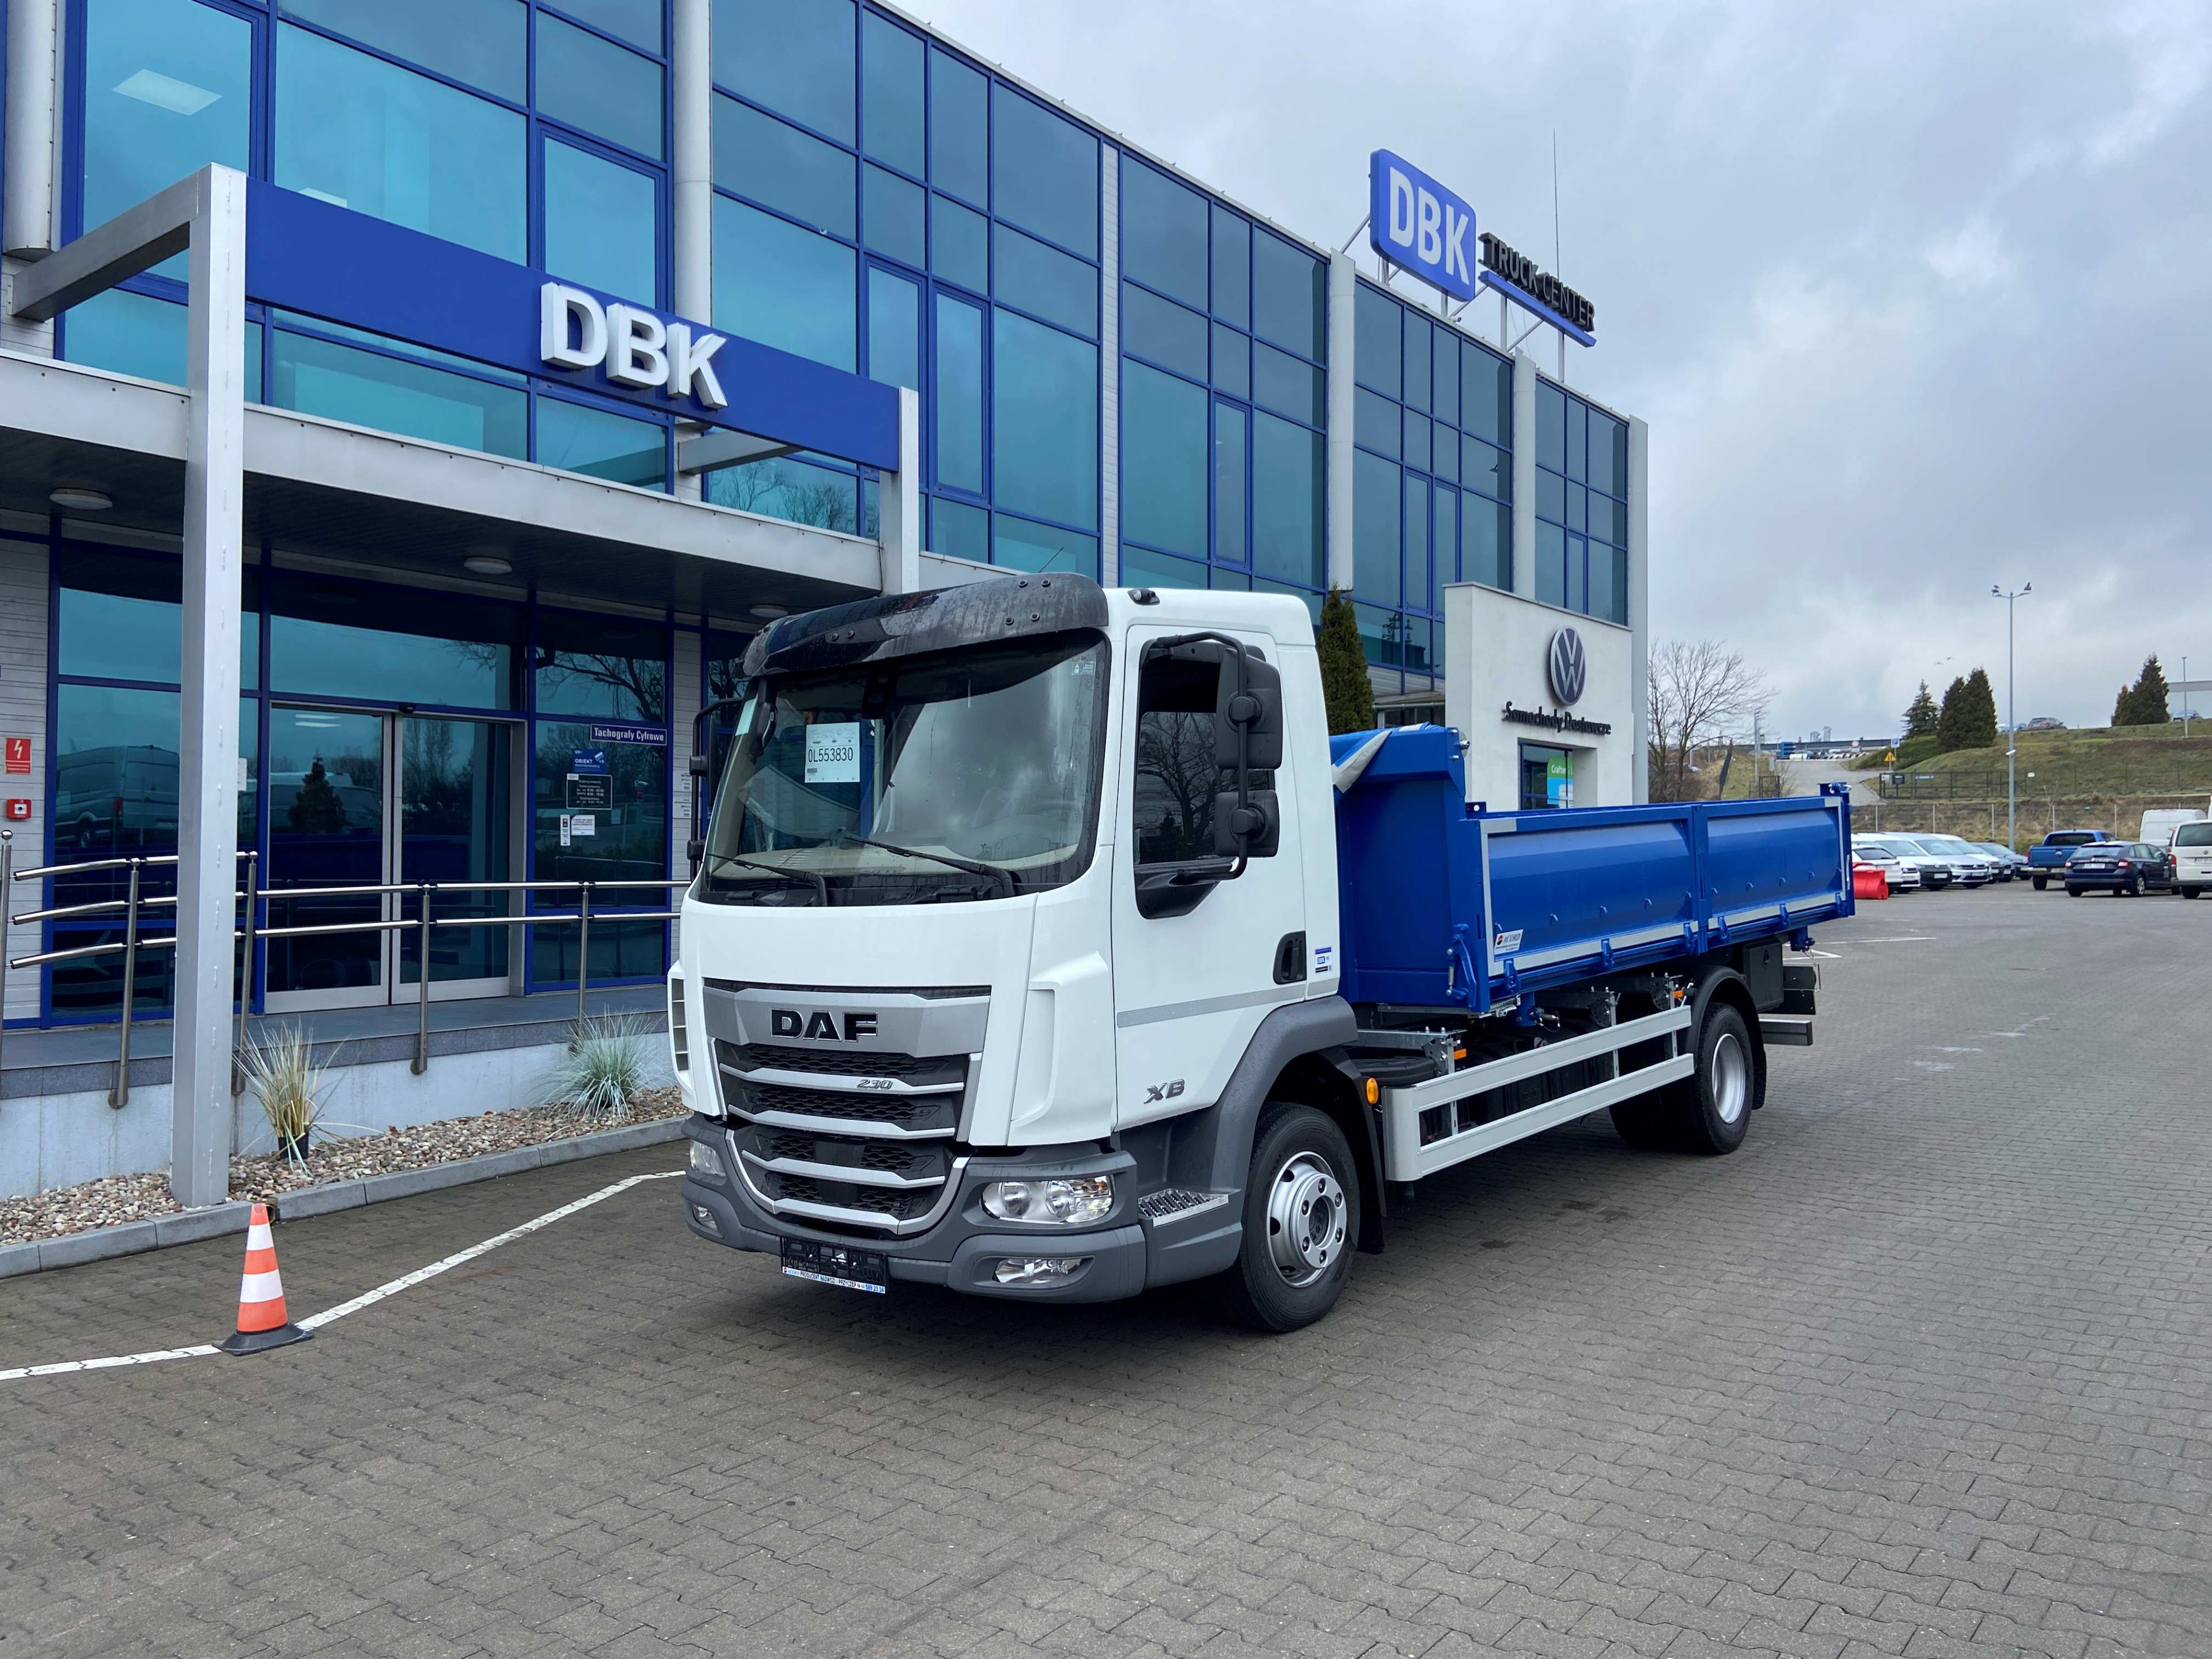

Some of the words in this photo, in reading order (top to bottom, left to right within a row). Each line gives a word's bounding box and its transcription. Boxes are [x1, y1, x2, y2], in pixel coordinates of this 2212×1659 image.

[1389, 166, 1469, 285] DBK
[1478, 232, 1539, 294] TRUCK
[1537, 272, 1595, 332] CENTER
[541, 282, 728, 410] DBK
[594, 728, 634, 741] Tachografy
[637, 730, 664, 741] Cyfrowe
[771, 1008, 878, 1042] DAF
[857, 1079, 893, 1090] 230
[1143, 1078, 1185, 1104] XB
